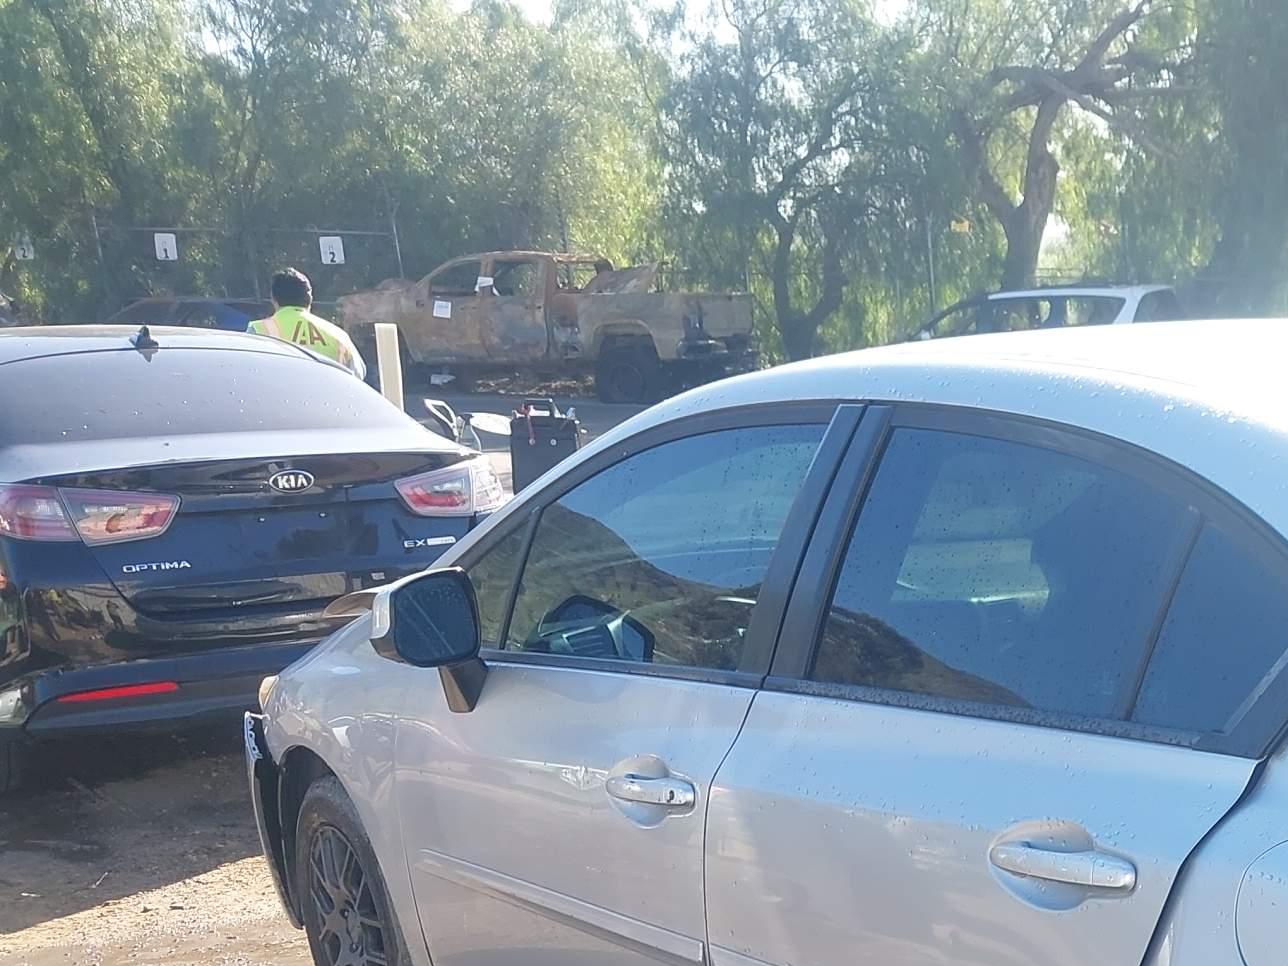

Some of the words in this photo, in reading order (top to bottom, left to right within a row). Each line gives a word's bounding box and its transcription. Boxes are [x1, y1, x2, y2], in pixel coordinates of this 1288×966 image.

[328, 251, 337, 263] 2
[277, 475, 308, 488] KIA
[403, 539, 426, 548] EX
[122, 560, 192, 573] OPTIMA
